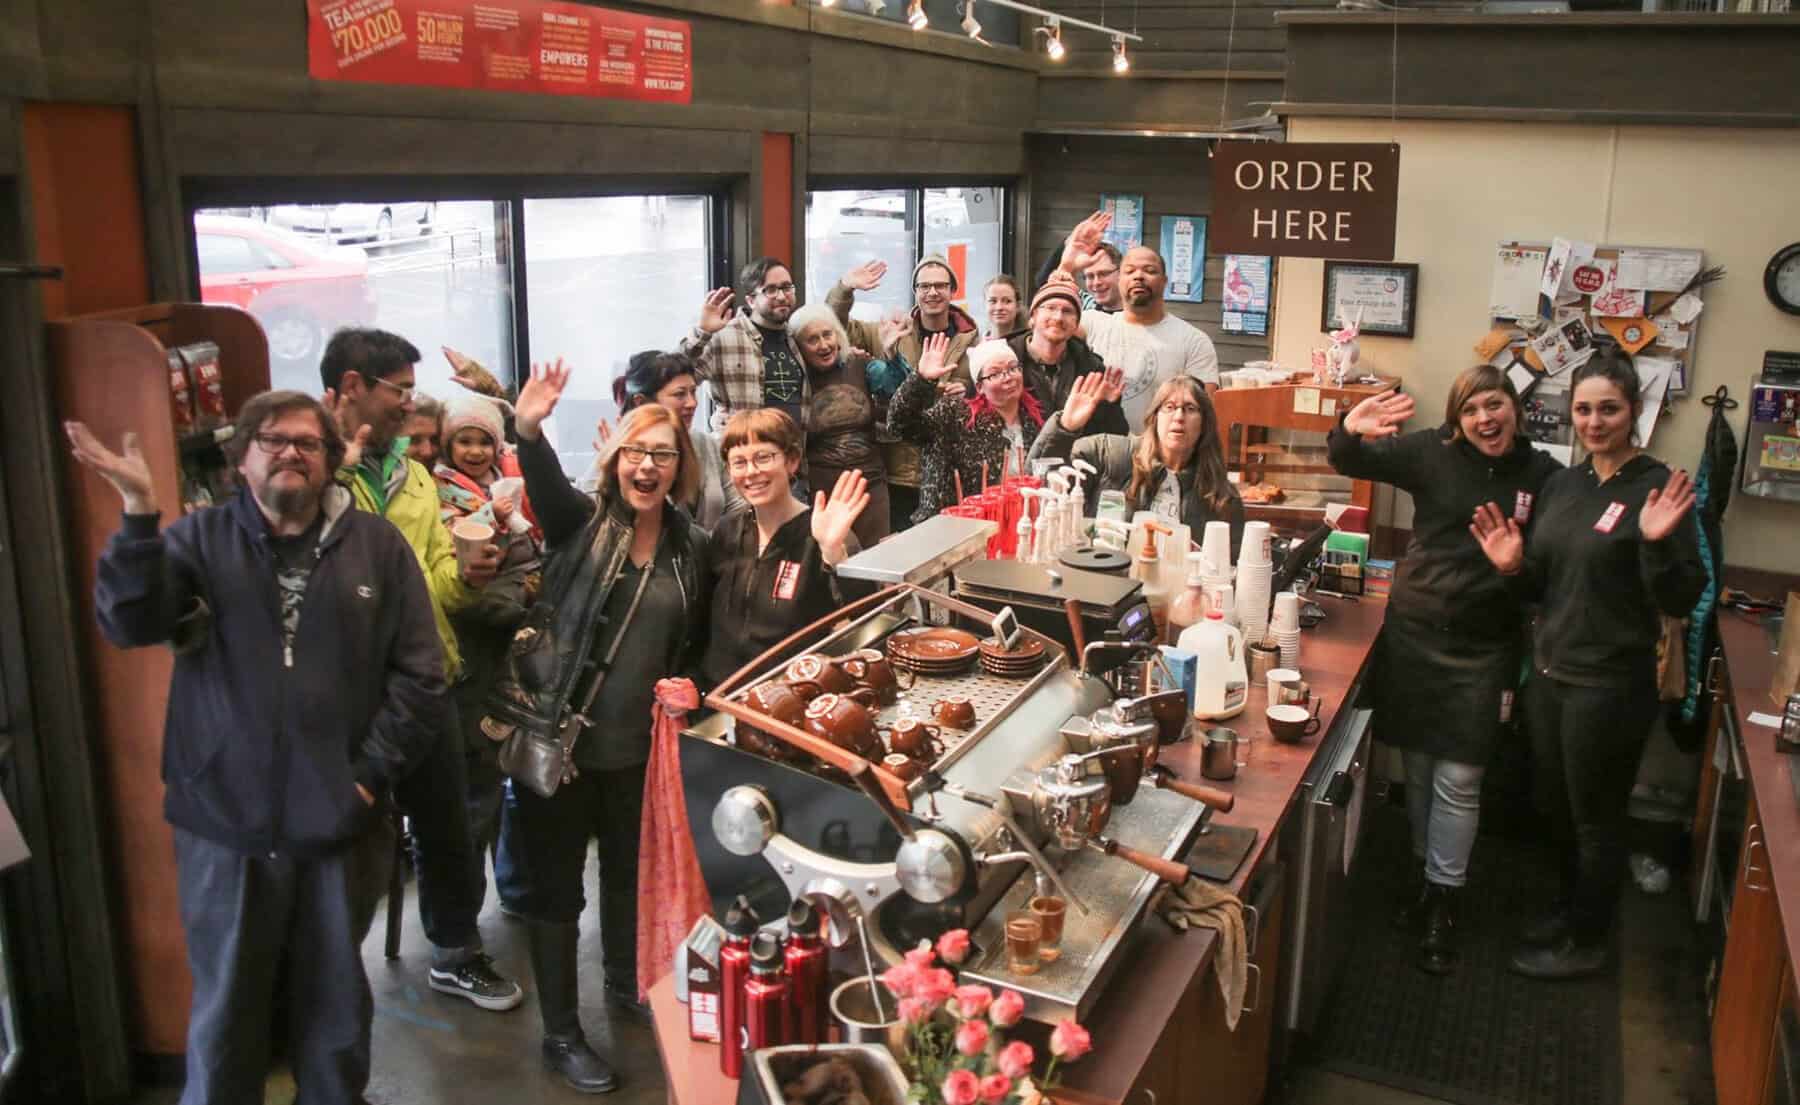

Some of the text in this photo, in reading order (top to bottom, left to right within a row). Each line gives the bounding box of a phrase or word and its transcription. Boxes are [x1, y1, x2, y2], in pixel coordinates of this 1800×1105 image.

[323, 8, 354, 31] TEA
[417, 16, 436, 43] 50
[540, 49, 588, 67] EMPOWERS
[1234, 160, 1375, 192] ORDER
[1252, 208, 1352, 241] HERE
